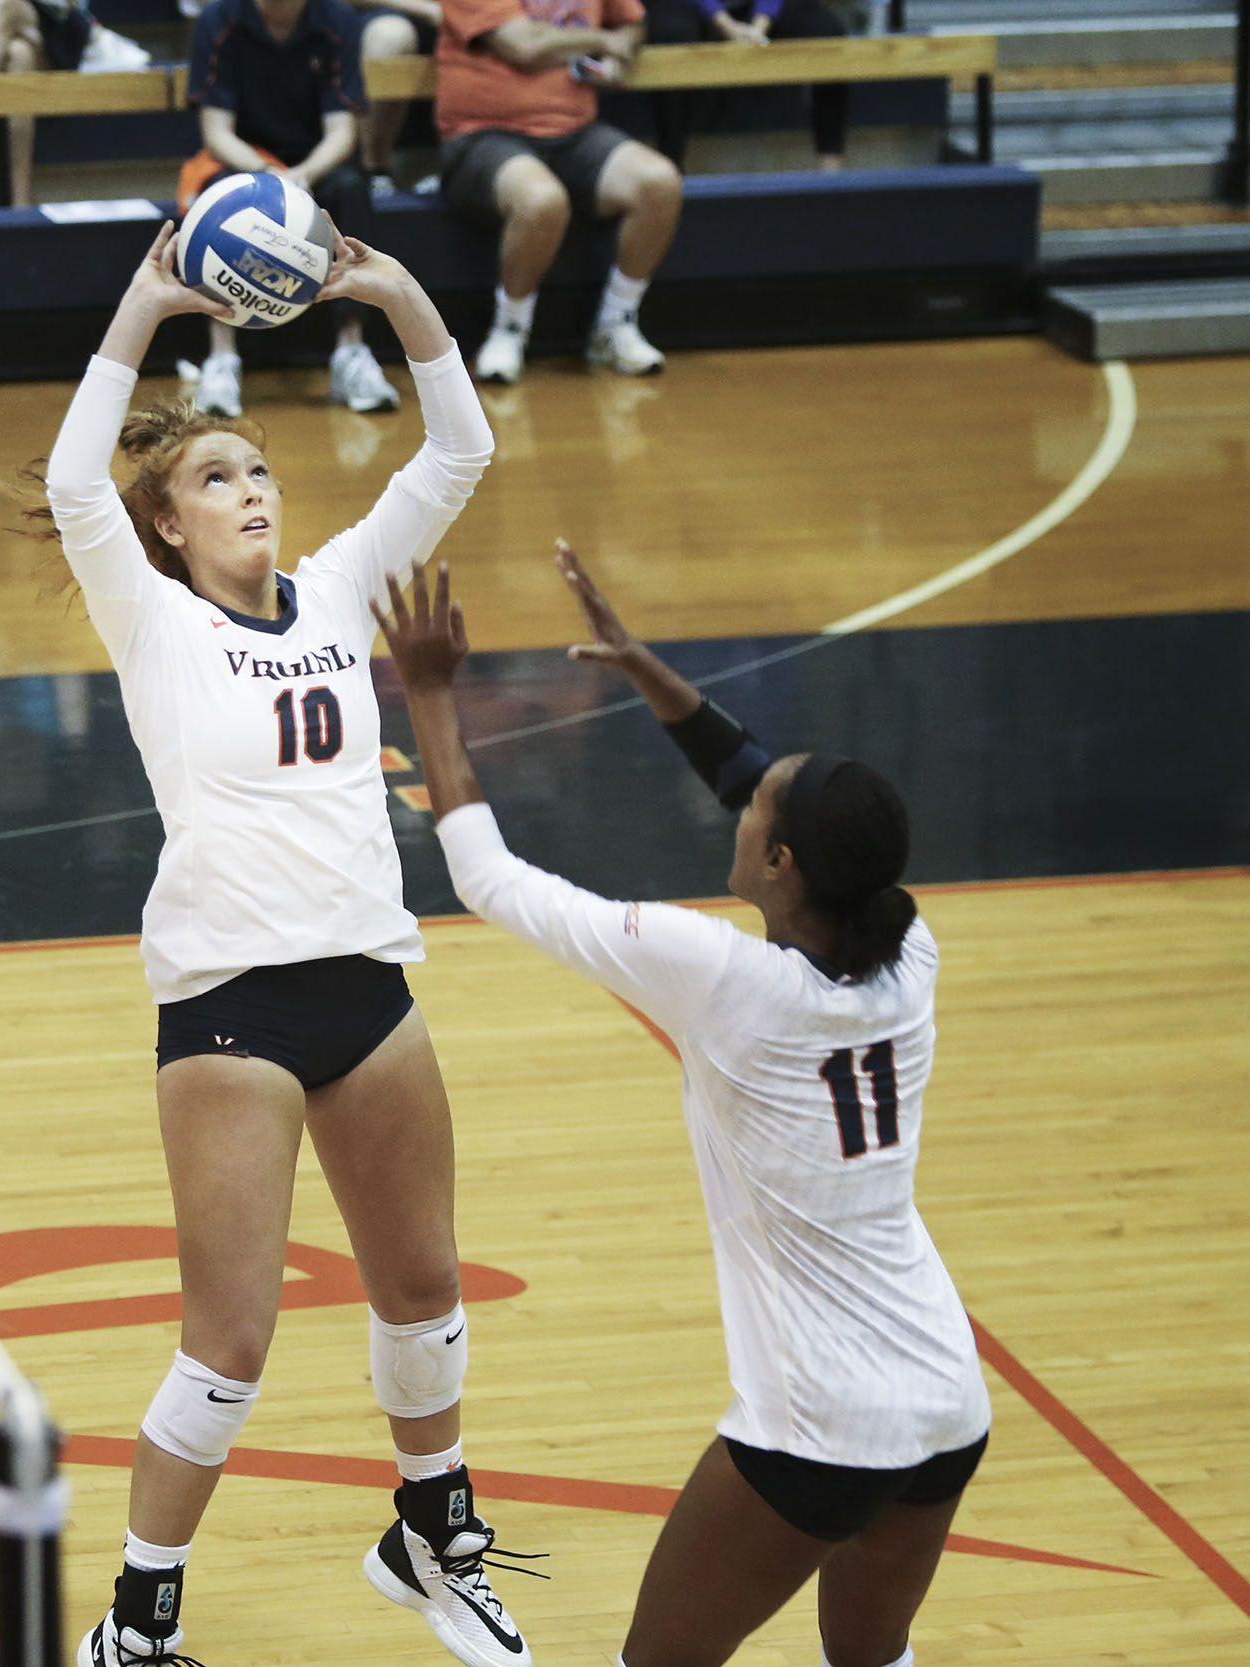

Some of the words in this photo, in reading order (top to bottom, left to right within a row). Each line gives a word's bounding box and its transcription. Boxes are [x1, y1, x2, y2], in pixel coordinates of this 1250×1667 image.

[216, 269, 292, 317] molten
[233, 248, 303, 298] NCAA
[273, 684, 344, 767] 10
[818, 1038, 900, 1161] 11
